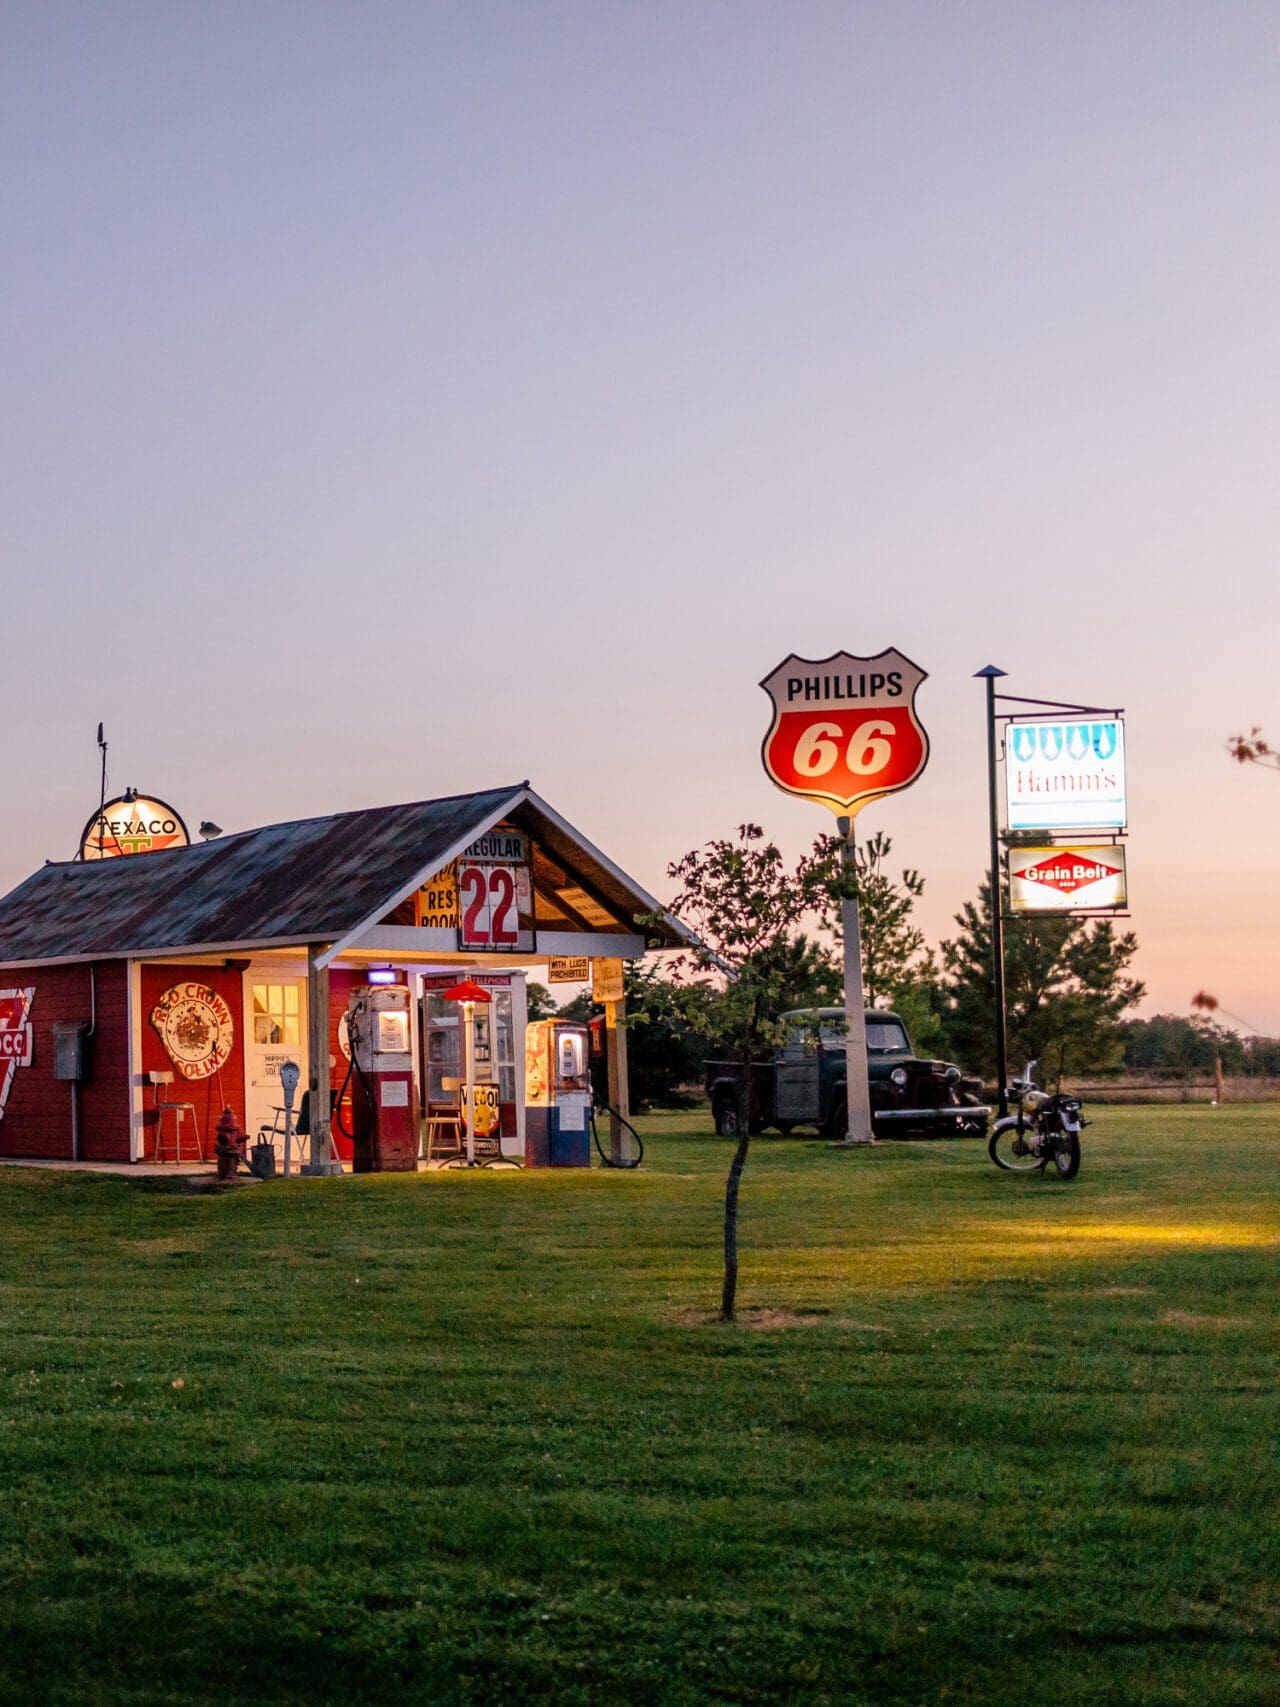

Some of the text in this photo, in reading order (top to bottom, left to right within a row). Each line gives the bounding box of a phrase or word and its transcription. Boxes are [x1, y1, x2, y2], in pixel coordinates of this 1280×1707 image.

[787, 671, 904, 702] PHILLIPS
[792, 719, 897, 778] 66
[1017, 767, 1117, 793] Hamm's
[97, 819, 177, 836] TEXACO
[1024, 864, 1108, 881] Grain Belt
[428, 889, 458, 911] RES
[460, 868, 518, 944] 22
[421, 913, 462, 929] ROOM
[550, 968, 587, 979] PROHIBITED
[551, 958, 587, 969] WITH LUGS
[472, 976, 510, 985] TELEPHONE
[154, 984, 231, 1027] RD CROWN
[461, 1087, 499, 1107] VEDOL
